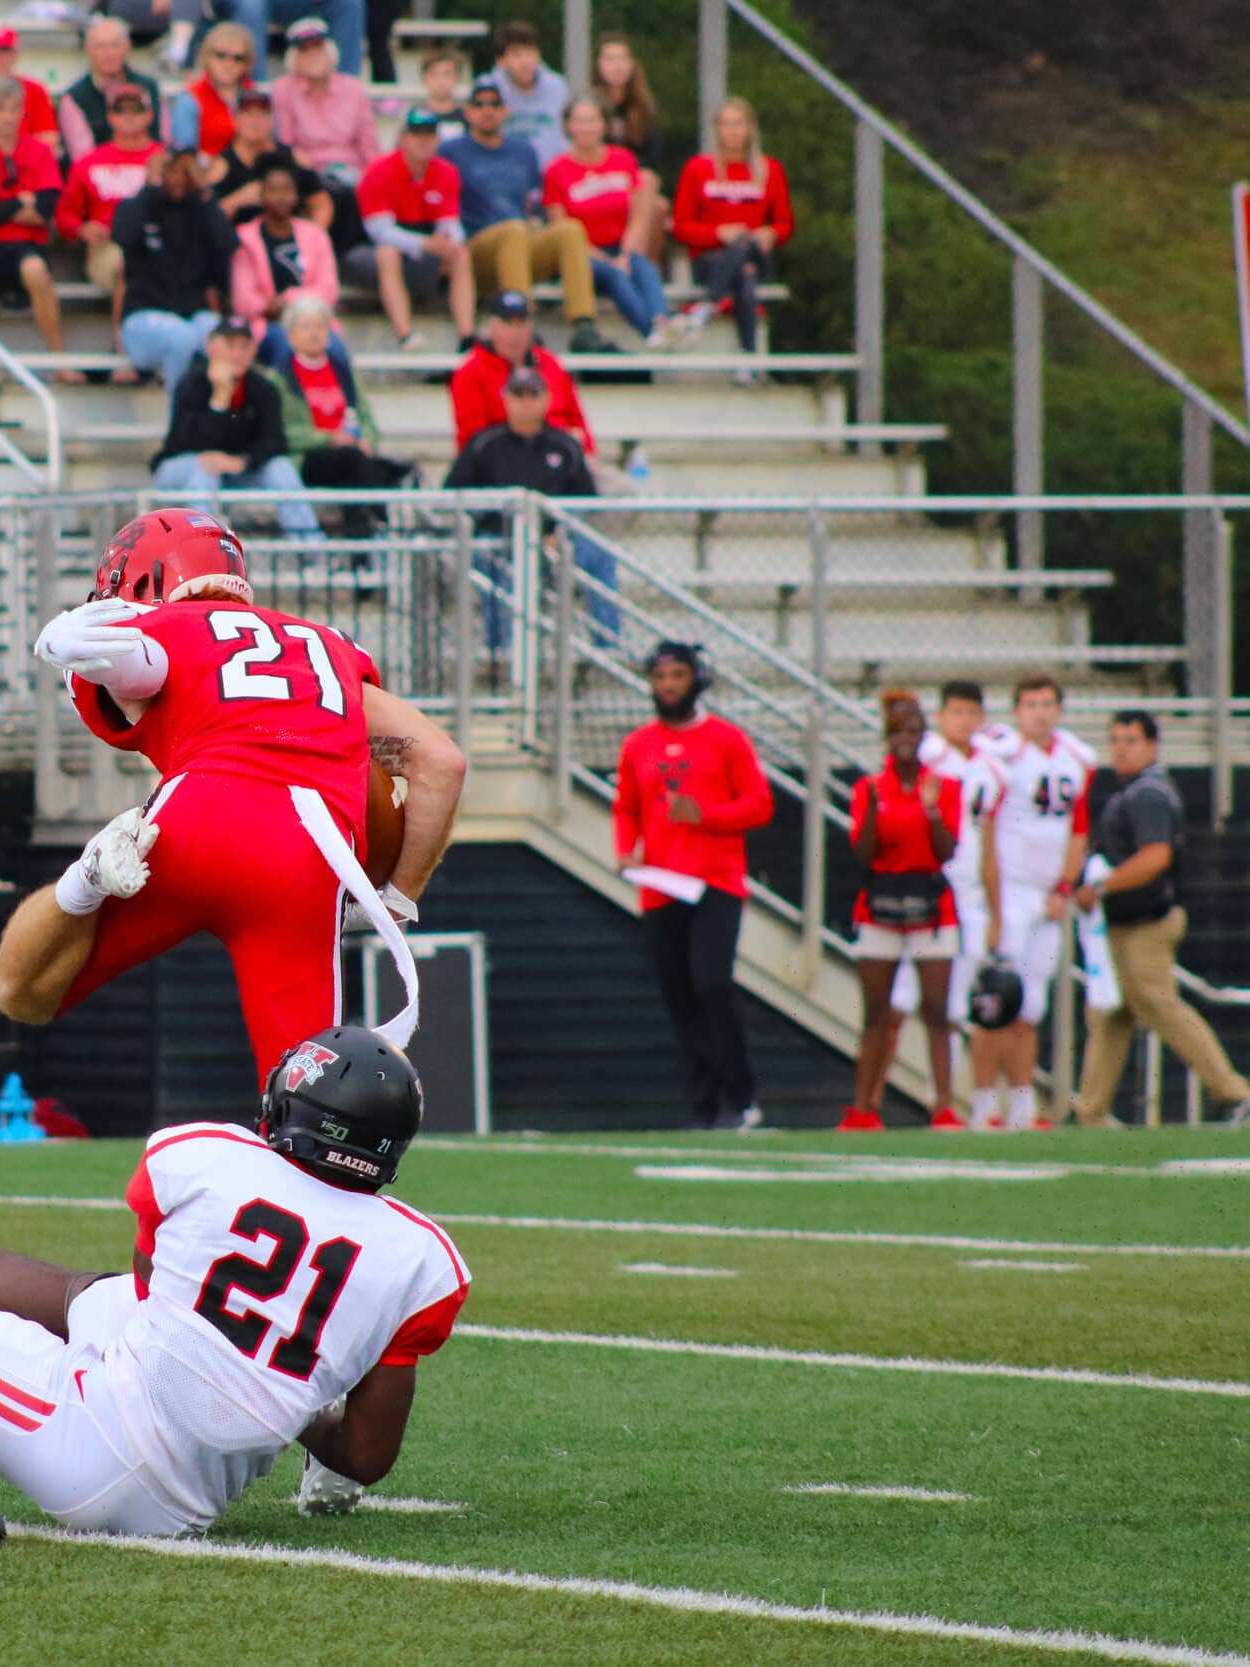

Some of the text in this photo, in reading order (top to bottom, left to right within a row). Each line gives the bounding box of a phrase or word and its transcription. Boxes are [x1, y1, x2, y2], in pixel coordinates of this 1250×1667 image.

[205, 609, 348, 720] 21
[325, 1150, 381, 1177] BLAZERS
[377, 1138, 392, 1154] 21
[193, 1197, 363, 1382] 21
